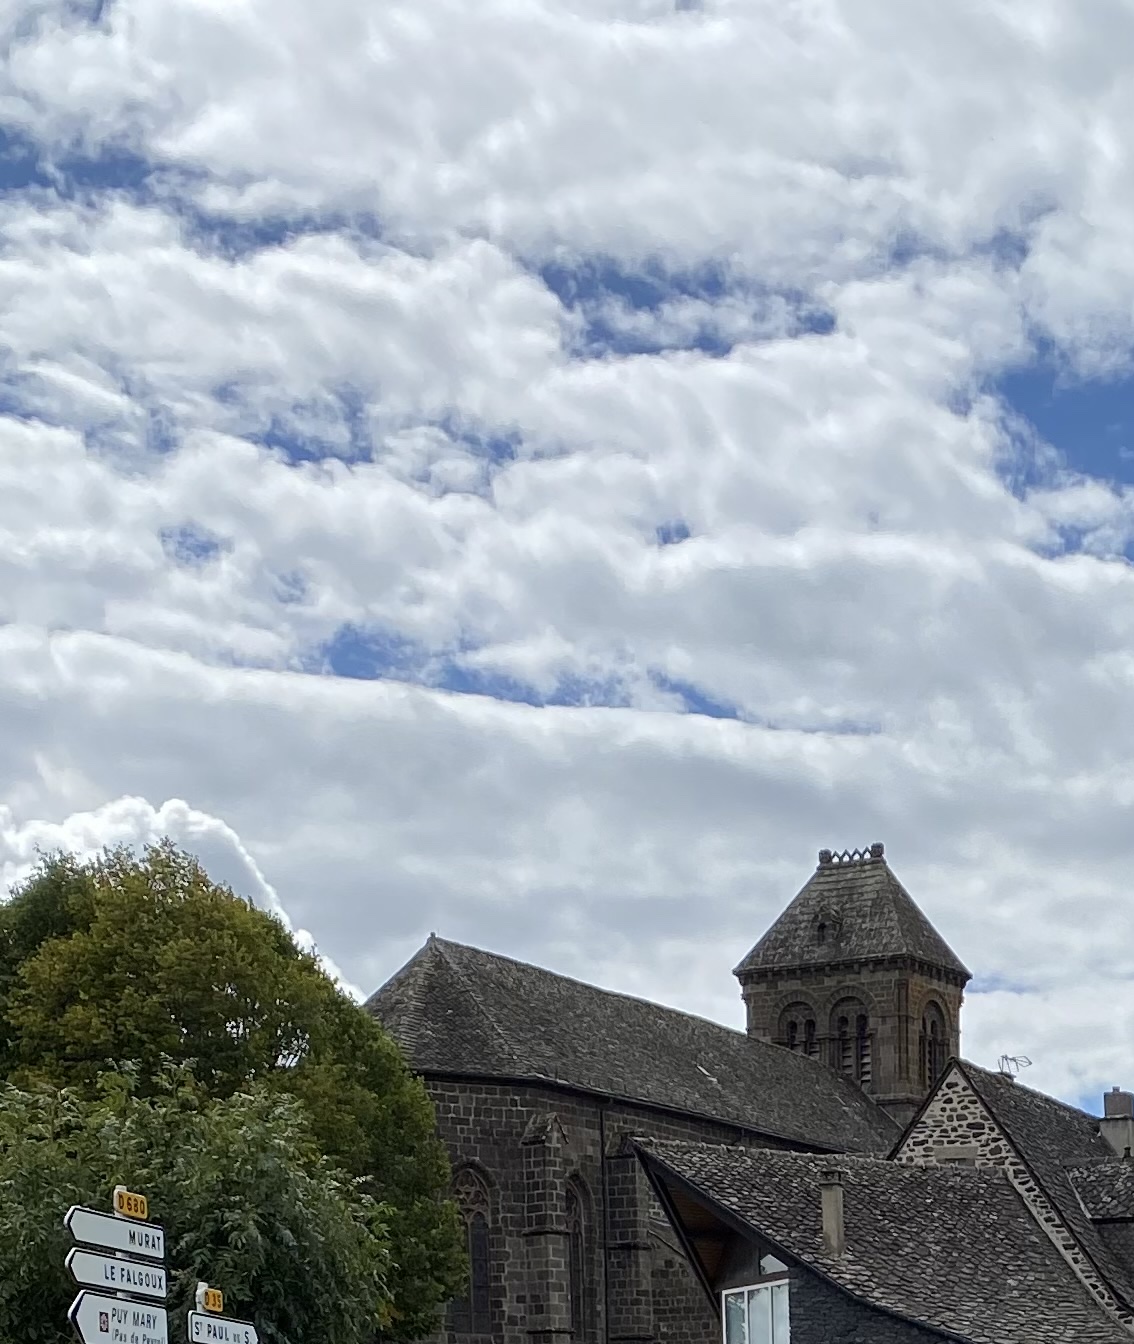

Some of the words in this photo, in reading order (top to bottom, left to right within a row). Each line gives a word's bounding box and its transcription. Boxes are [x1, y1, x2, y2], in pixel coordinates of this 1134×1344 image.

[118, 1193, 125, 1210] D
[126, 1196, 146, 1215] 680
[128, 1229, 161, 1252] MURAT
[103, 1263, 116, 1281] LE
[120, 1267, 164, 1291] FALGOUX
[111, 1307, 129, 1325] PUY
[132, 1311, 158, 1330] MARY
[130, 1331, 139, 1344] de
[206, 1323, 230, 1342] PAUL
